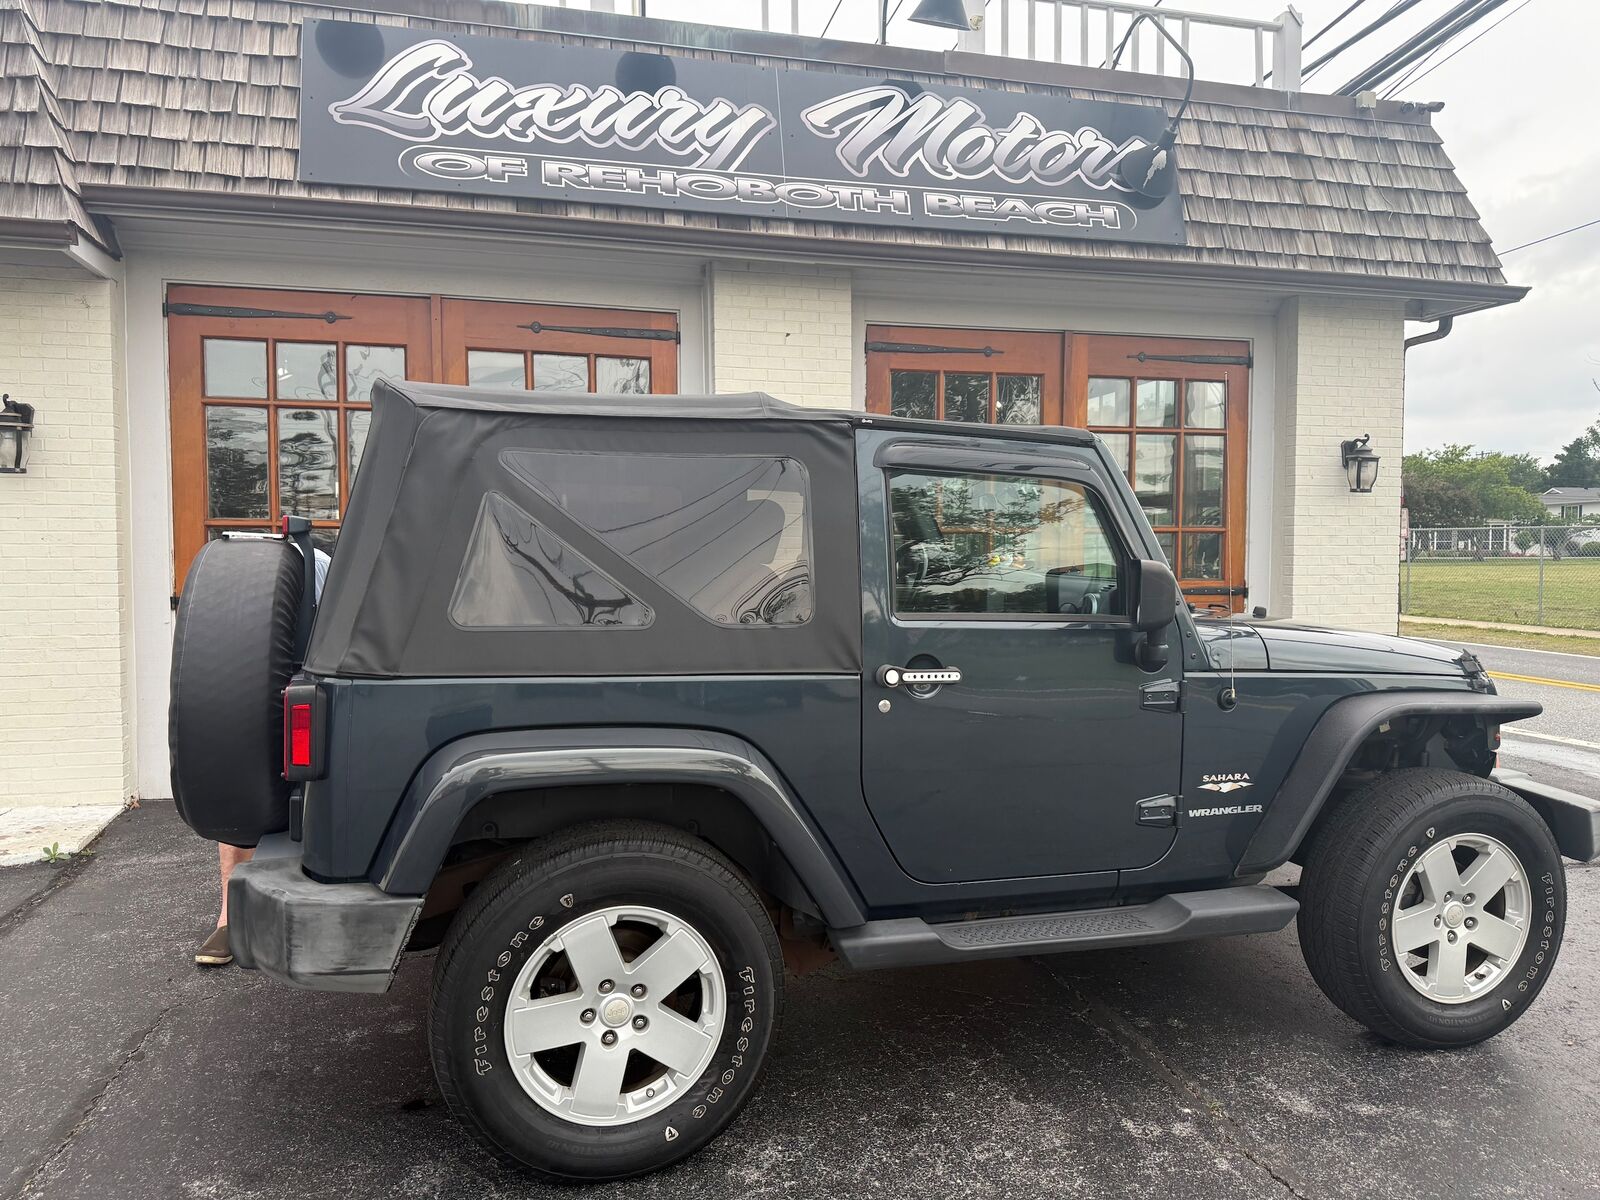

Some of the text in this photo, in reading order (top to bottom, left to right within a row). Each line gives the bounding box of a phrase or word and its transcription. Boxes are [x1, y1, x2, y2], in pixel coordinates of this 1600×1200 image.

[328, 38, 1152, 192] Luxury Motor
[411, 150, 1122, 231] OF REHOBOTH BEACH
[1188, 805, 1262, 817] WRANGLER
[1202, 773, 1250, 782] SAHARA
[1518, 872, 1553, 991] Firestone
[474, 916, 544, 1075] Firestone
[692, 966, 754, 1118] Firestone
